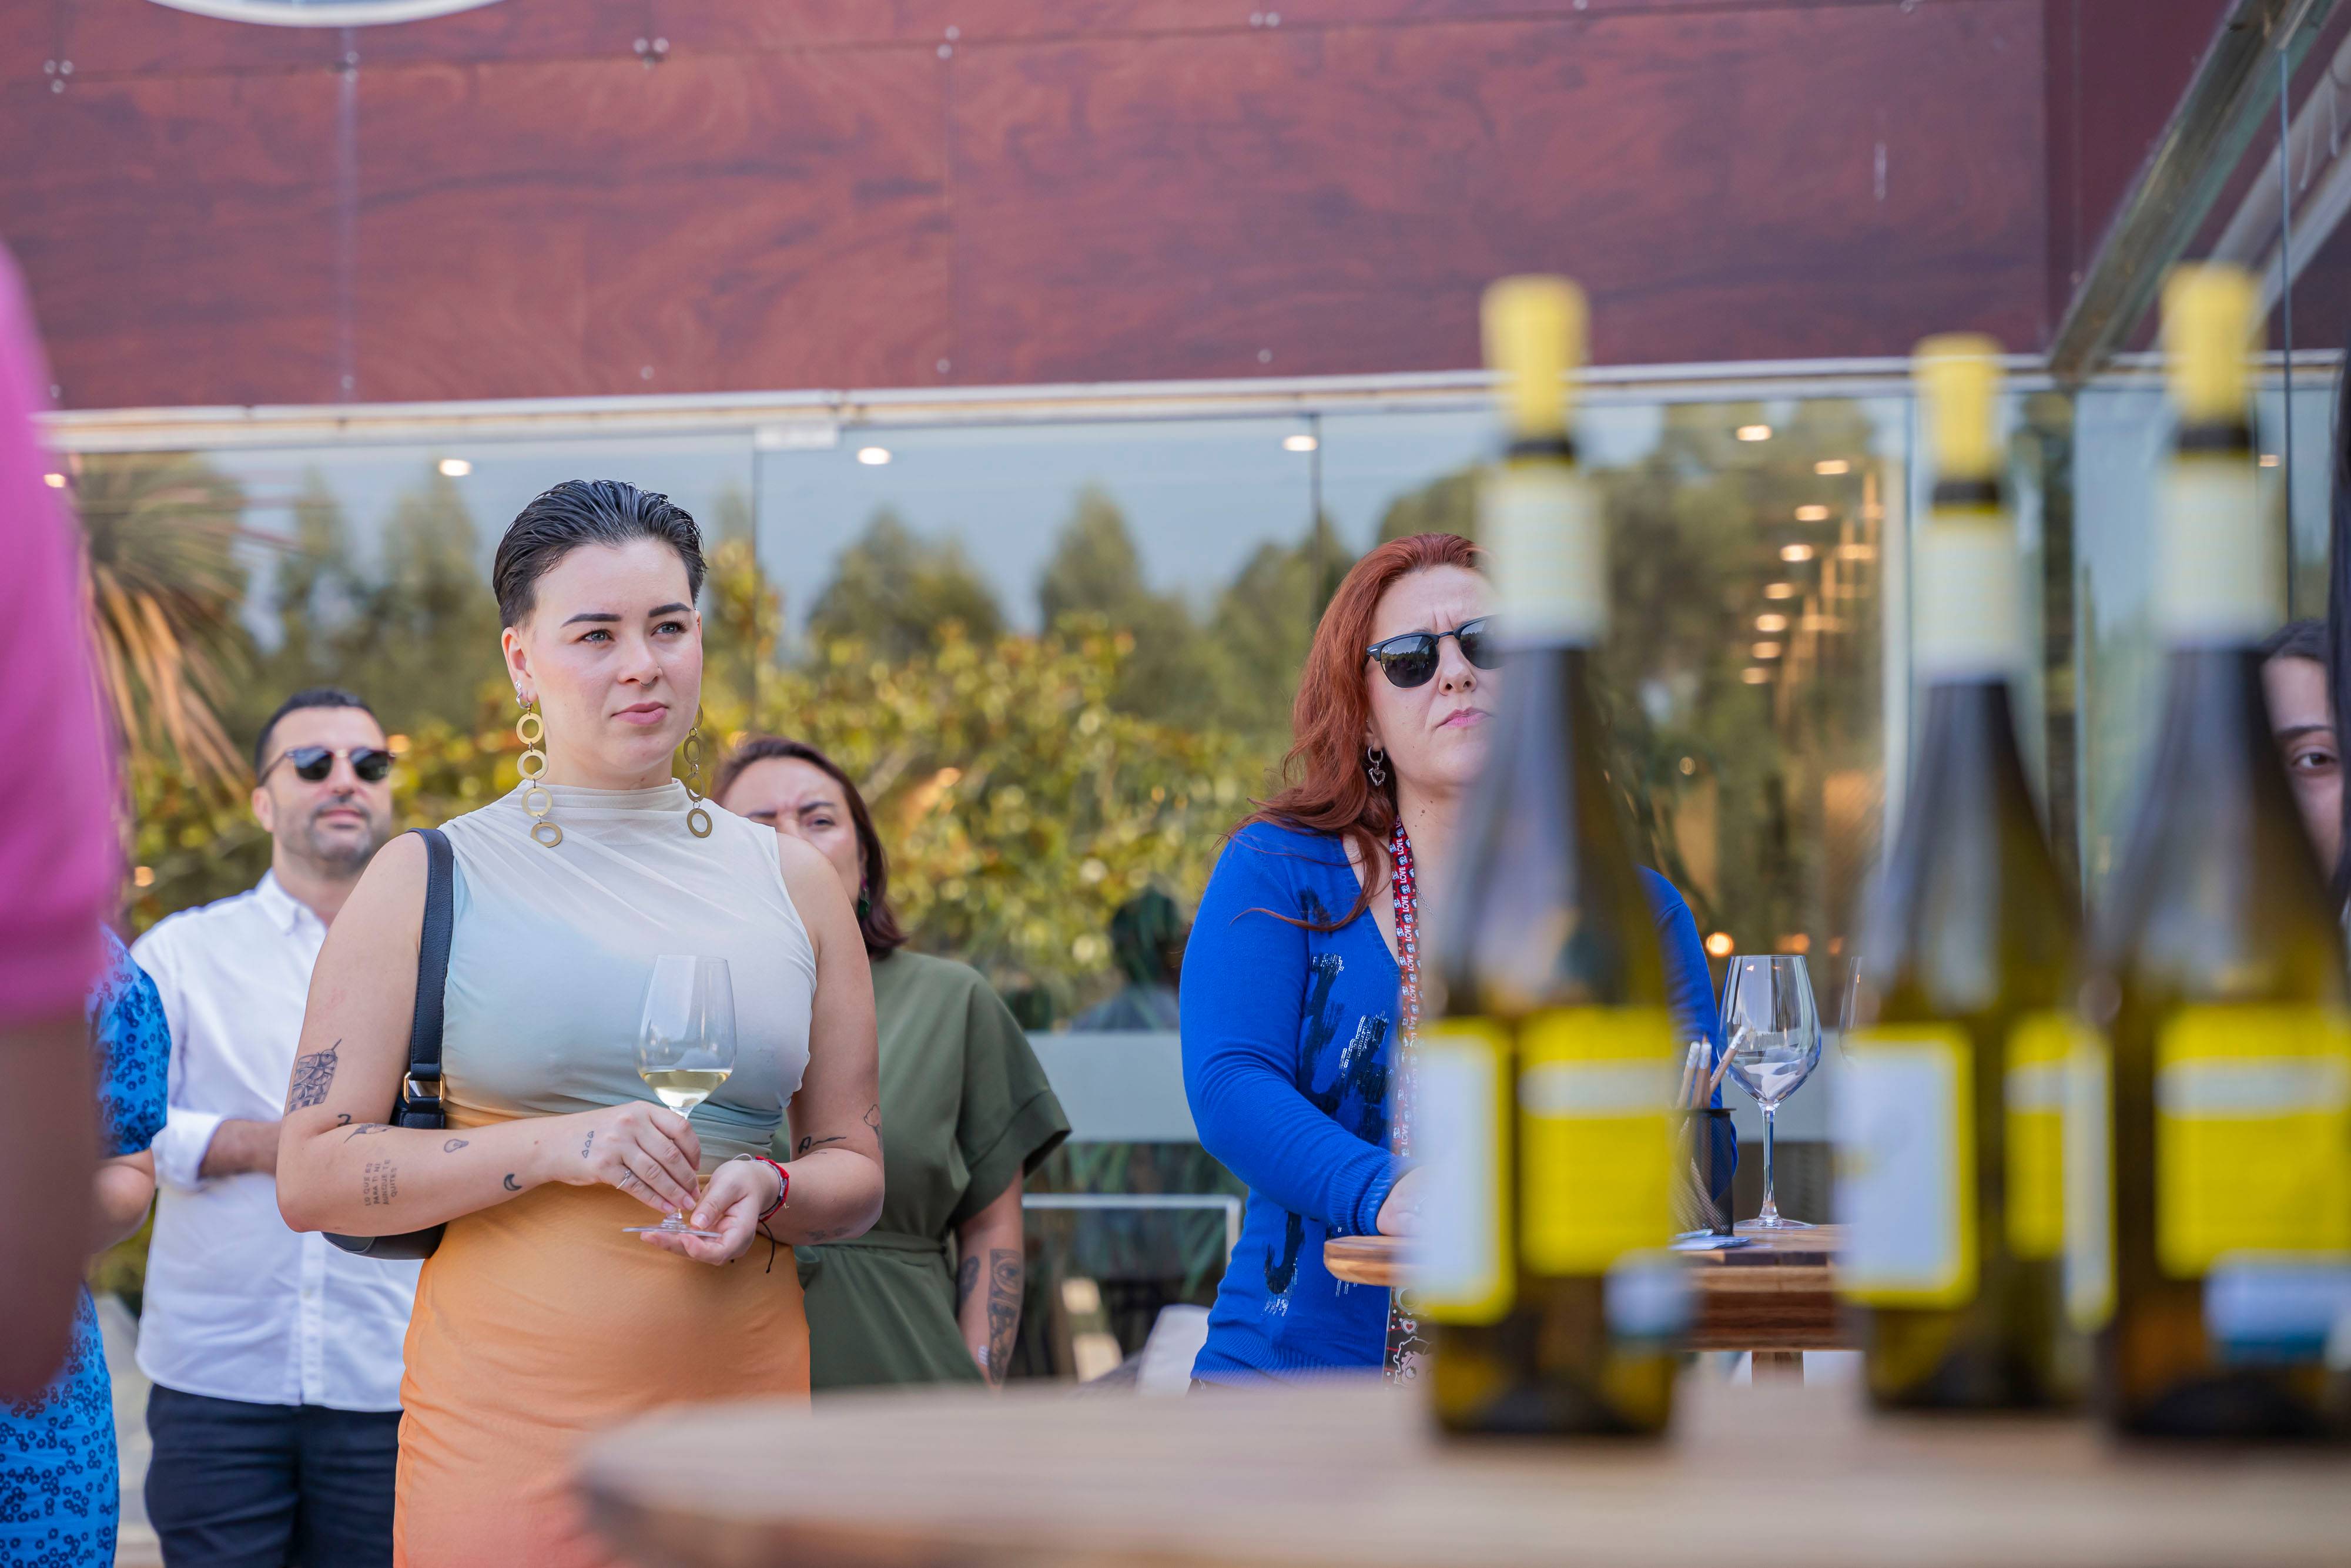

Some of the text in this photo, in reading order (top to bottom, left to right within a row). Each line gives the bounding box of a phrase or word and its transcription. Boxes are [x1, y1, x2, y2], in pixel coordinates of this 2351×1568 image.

[1396, 838, 1404, 855] LOVE
[1399, 866, 1407, 883] LOVE
[1401, 895, 1409, 912] LOVE
[1401, 1124, 1409, 1145] LOVE
